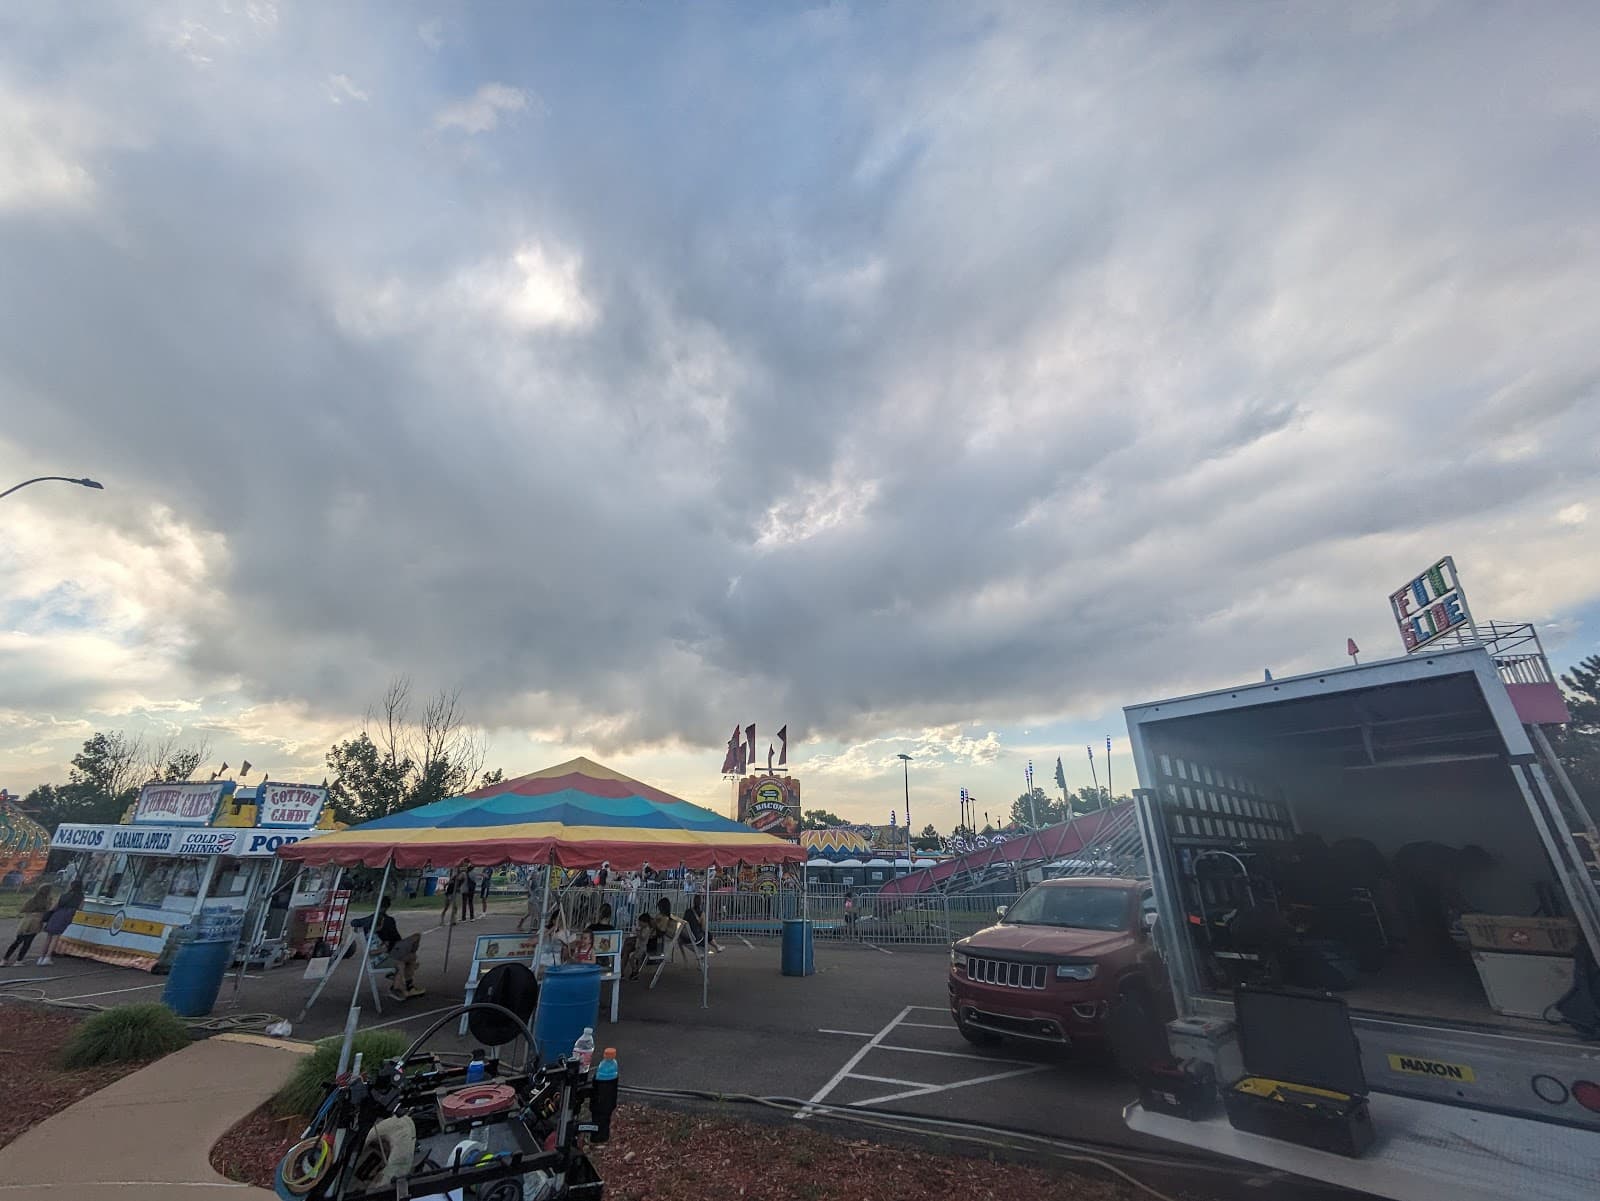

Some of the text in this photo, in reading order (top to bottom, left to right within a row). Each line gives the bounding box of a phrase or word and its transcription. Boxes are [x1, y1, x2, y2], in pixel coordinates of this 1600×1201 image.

[140, 789, 218, 818] FUNNEL CAKES
[271, 789, 321, 807] COTTON
[270, 808, 311, 822] CANDY
[755, 803, 785, 812] BACON
[56, 829, 104, 846] NACHOS
[113, 831, 172, 850] CARAMEL APPLES
[186, 833, 217, 844] COLD
[179, 844, 223, 854] DRINKS
[1400, 1058, 1463, 1079] MAXON
